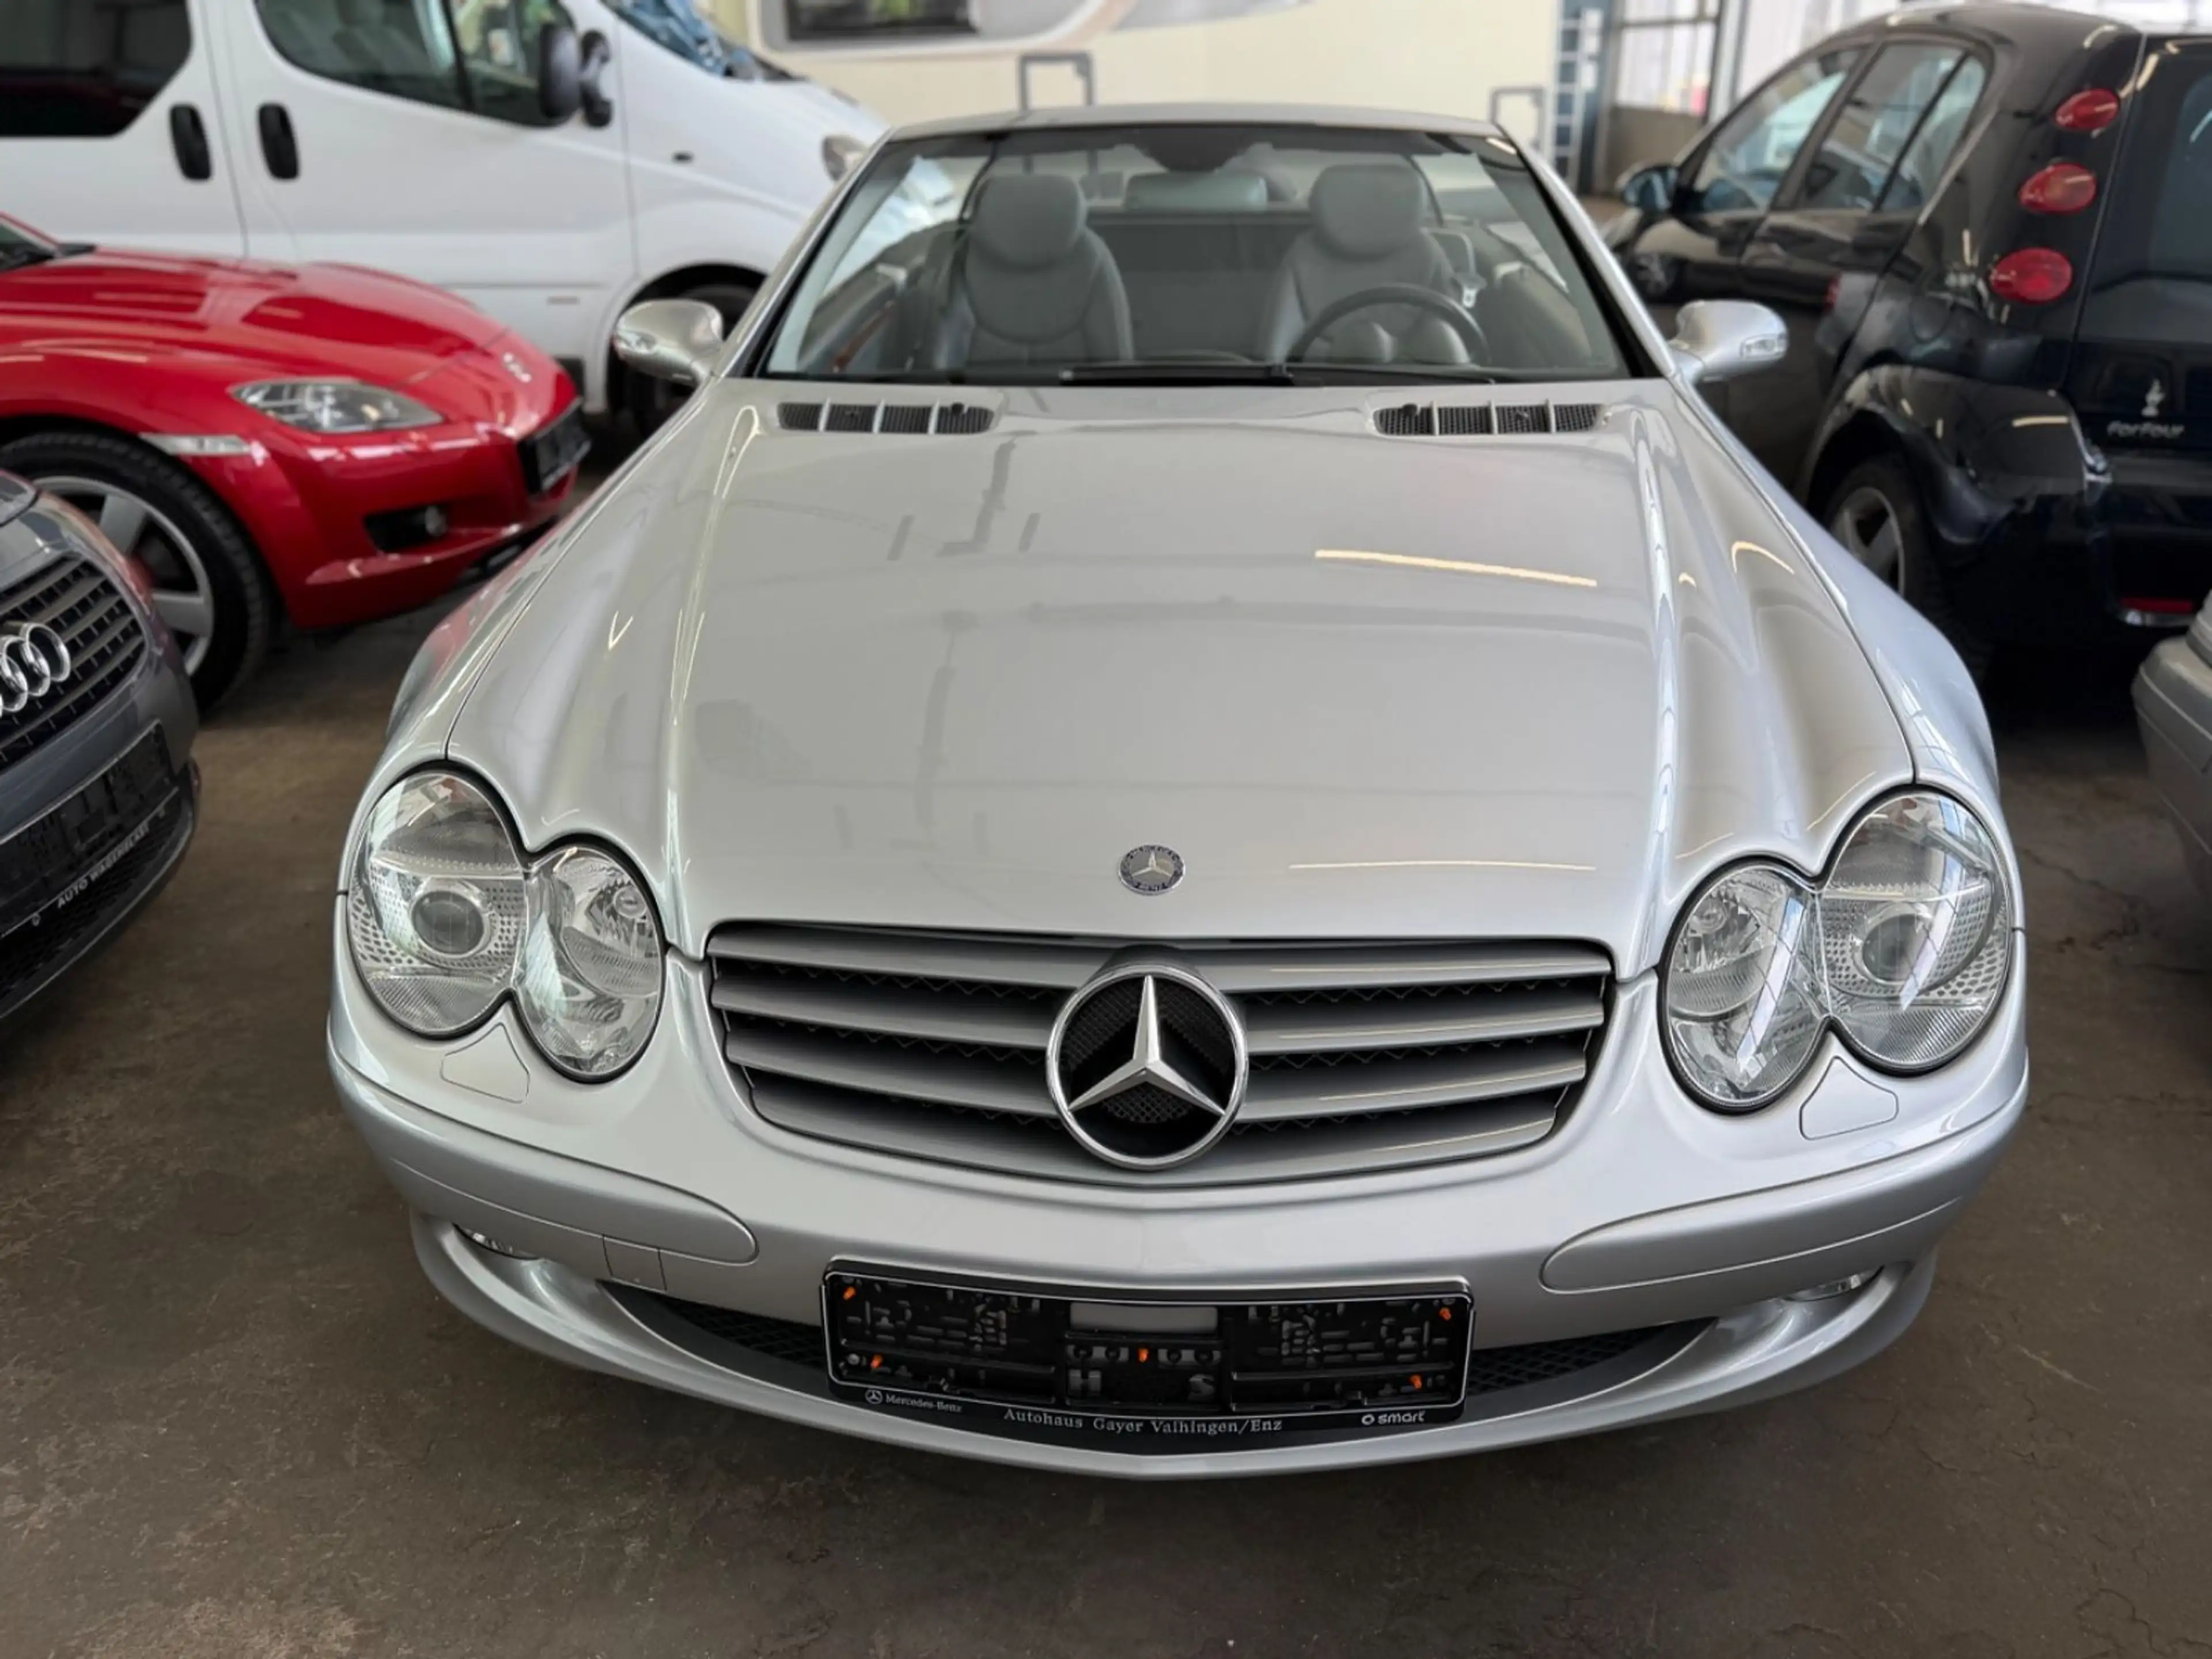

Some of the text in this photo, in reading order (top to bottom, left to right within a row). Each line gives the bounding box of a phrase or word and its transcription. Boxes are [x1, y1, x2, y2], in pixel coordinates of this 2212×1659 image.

[886, 1394, 963, 1412] Mercedes-Benz
[1004, 1408, 1083, 1429] Autohaus
[1093, 1417, 1143, 1433] Gayer
[1378, 1410, 1426, 1425] smart
